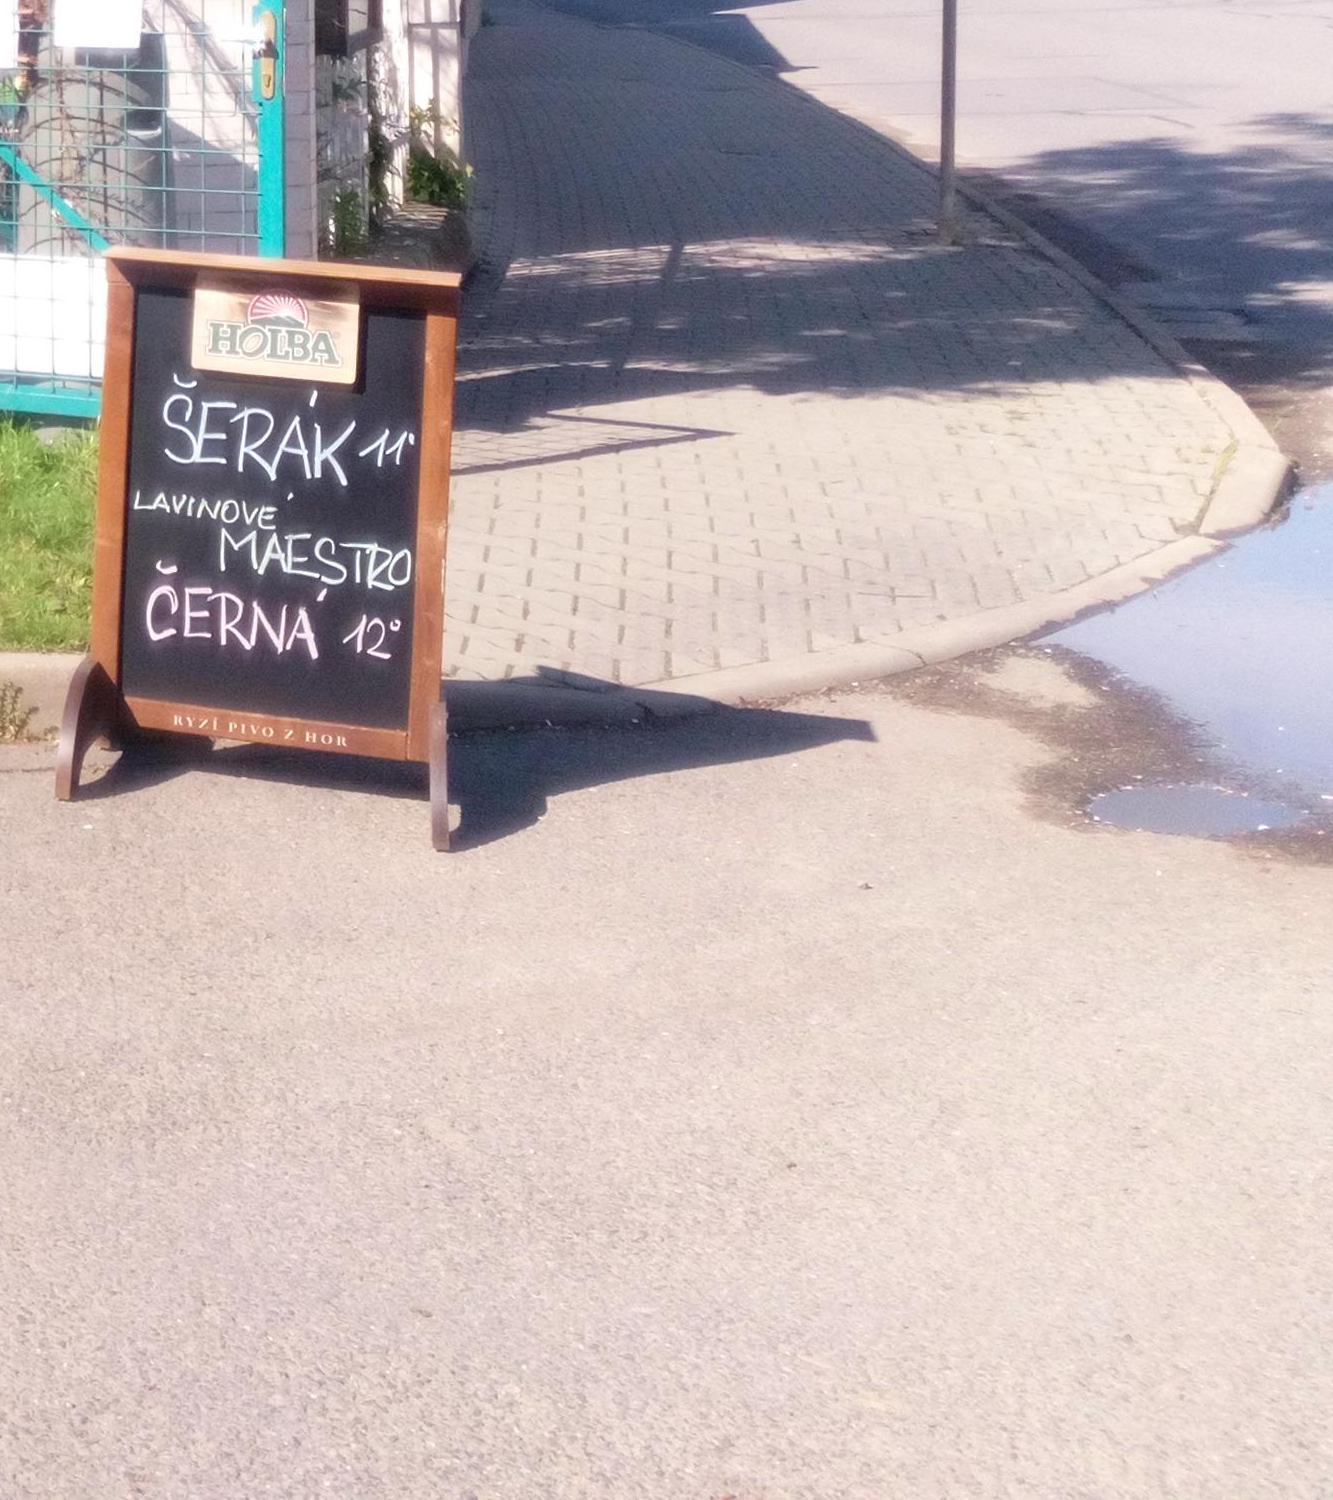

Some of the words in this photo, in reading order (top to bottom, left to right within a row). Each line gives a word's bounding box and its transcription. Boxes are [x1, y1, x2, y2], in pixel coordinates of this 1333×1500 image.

[205, 319, 341, 368] HOLBA
[163, 373, 355, 486] ŠERÁK
[219, 527, 412, 591] MAESTRO
[146, 560, 327, 660] ČERNÁ
[172, 714, 218, 731] RYZÍ
[228, 721, 275, 738] PIVO
[284, 729, 295, 740] Z
[304, 731, 348, 748] HOR
